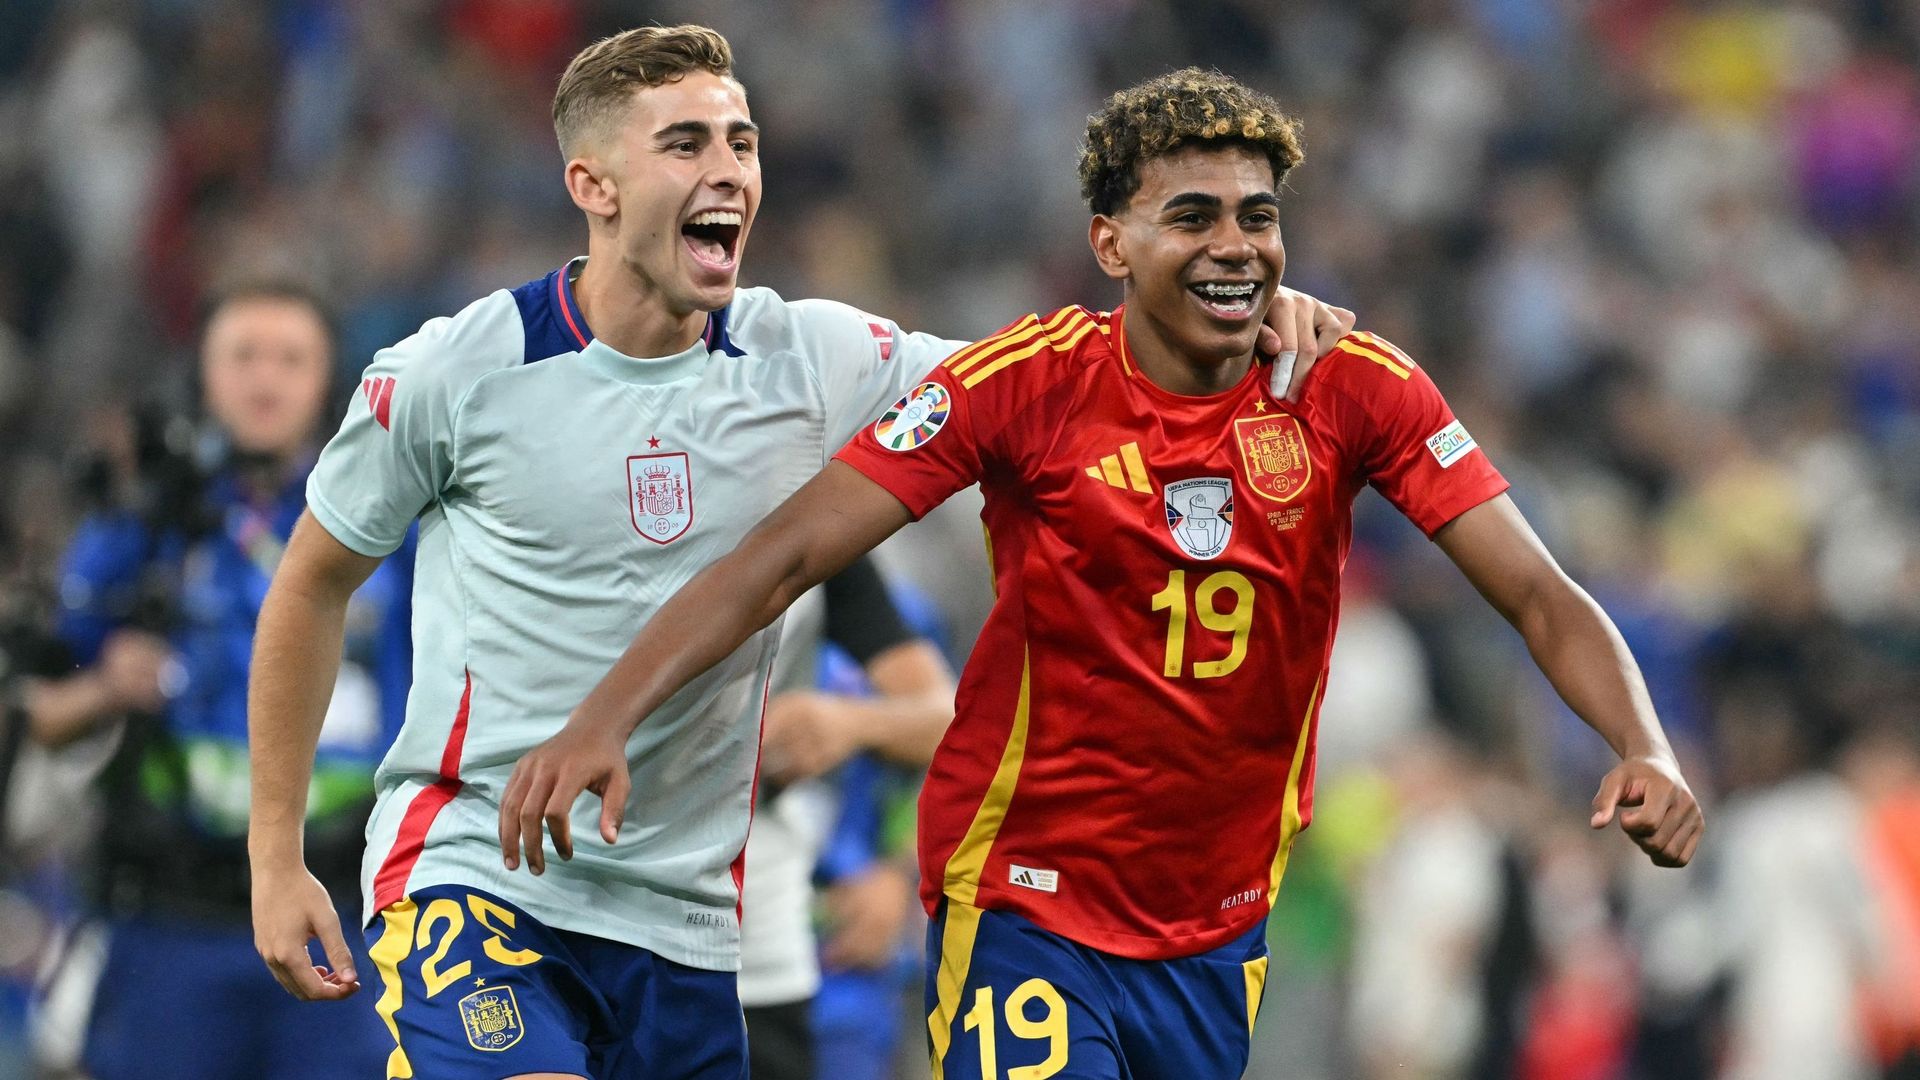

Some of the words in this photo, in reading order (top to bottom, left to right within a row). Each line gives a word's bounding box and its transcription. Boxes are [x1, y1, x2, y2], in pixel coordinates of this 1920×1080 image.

[1429, 433, 1447, 447] UEFA
[1434, 432, 1467, 458] FOUN
[1182, 480, 1206, 488] NATIONS
[1189, 549, 1210, 557] WINNER
[1152, 570, 1255, 678] 19
[1221, 888, 1261, 910] HEAT.RDY
[416, 894, 543, 998] 25
[964, 978, 1068, 1080] 19
